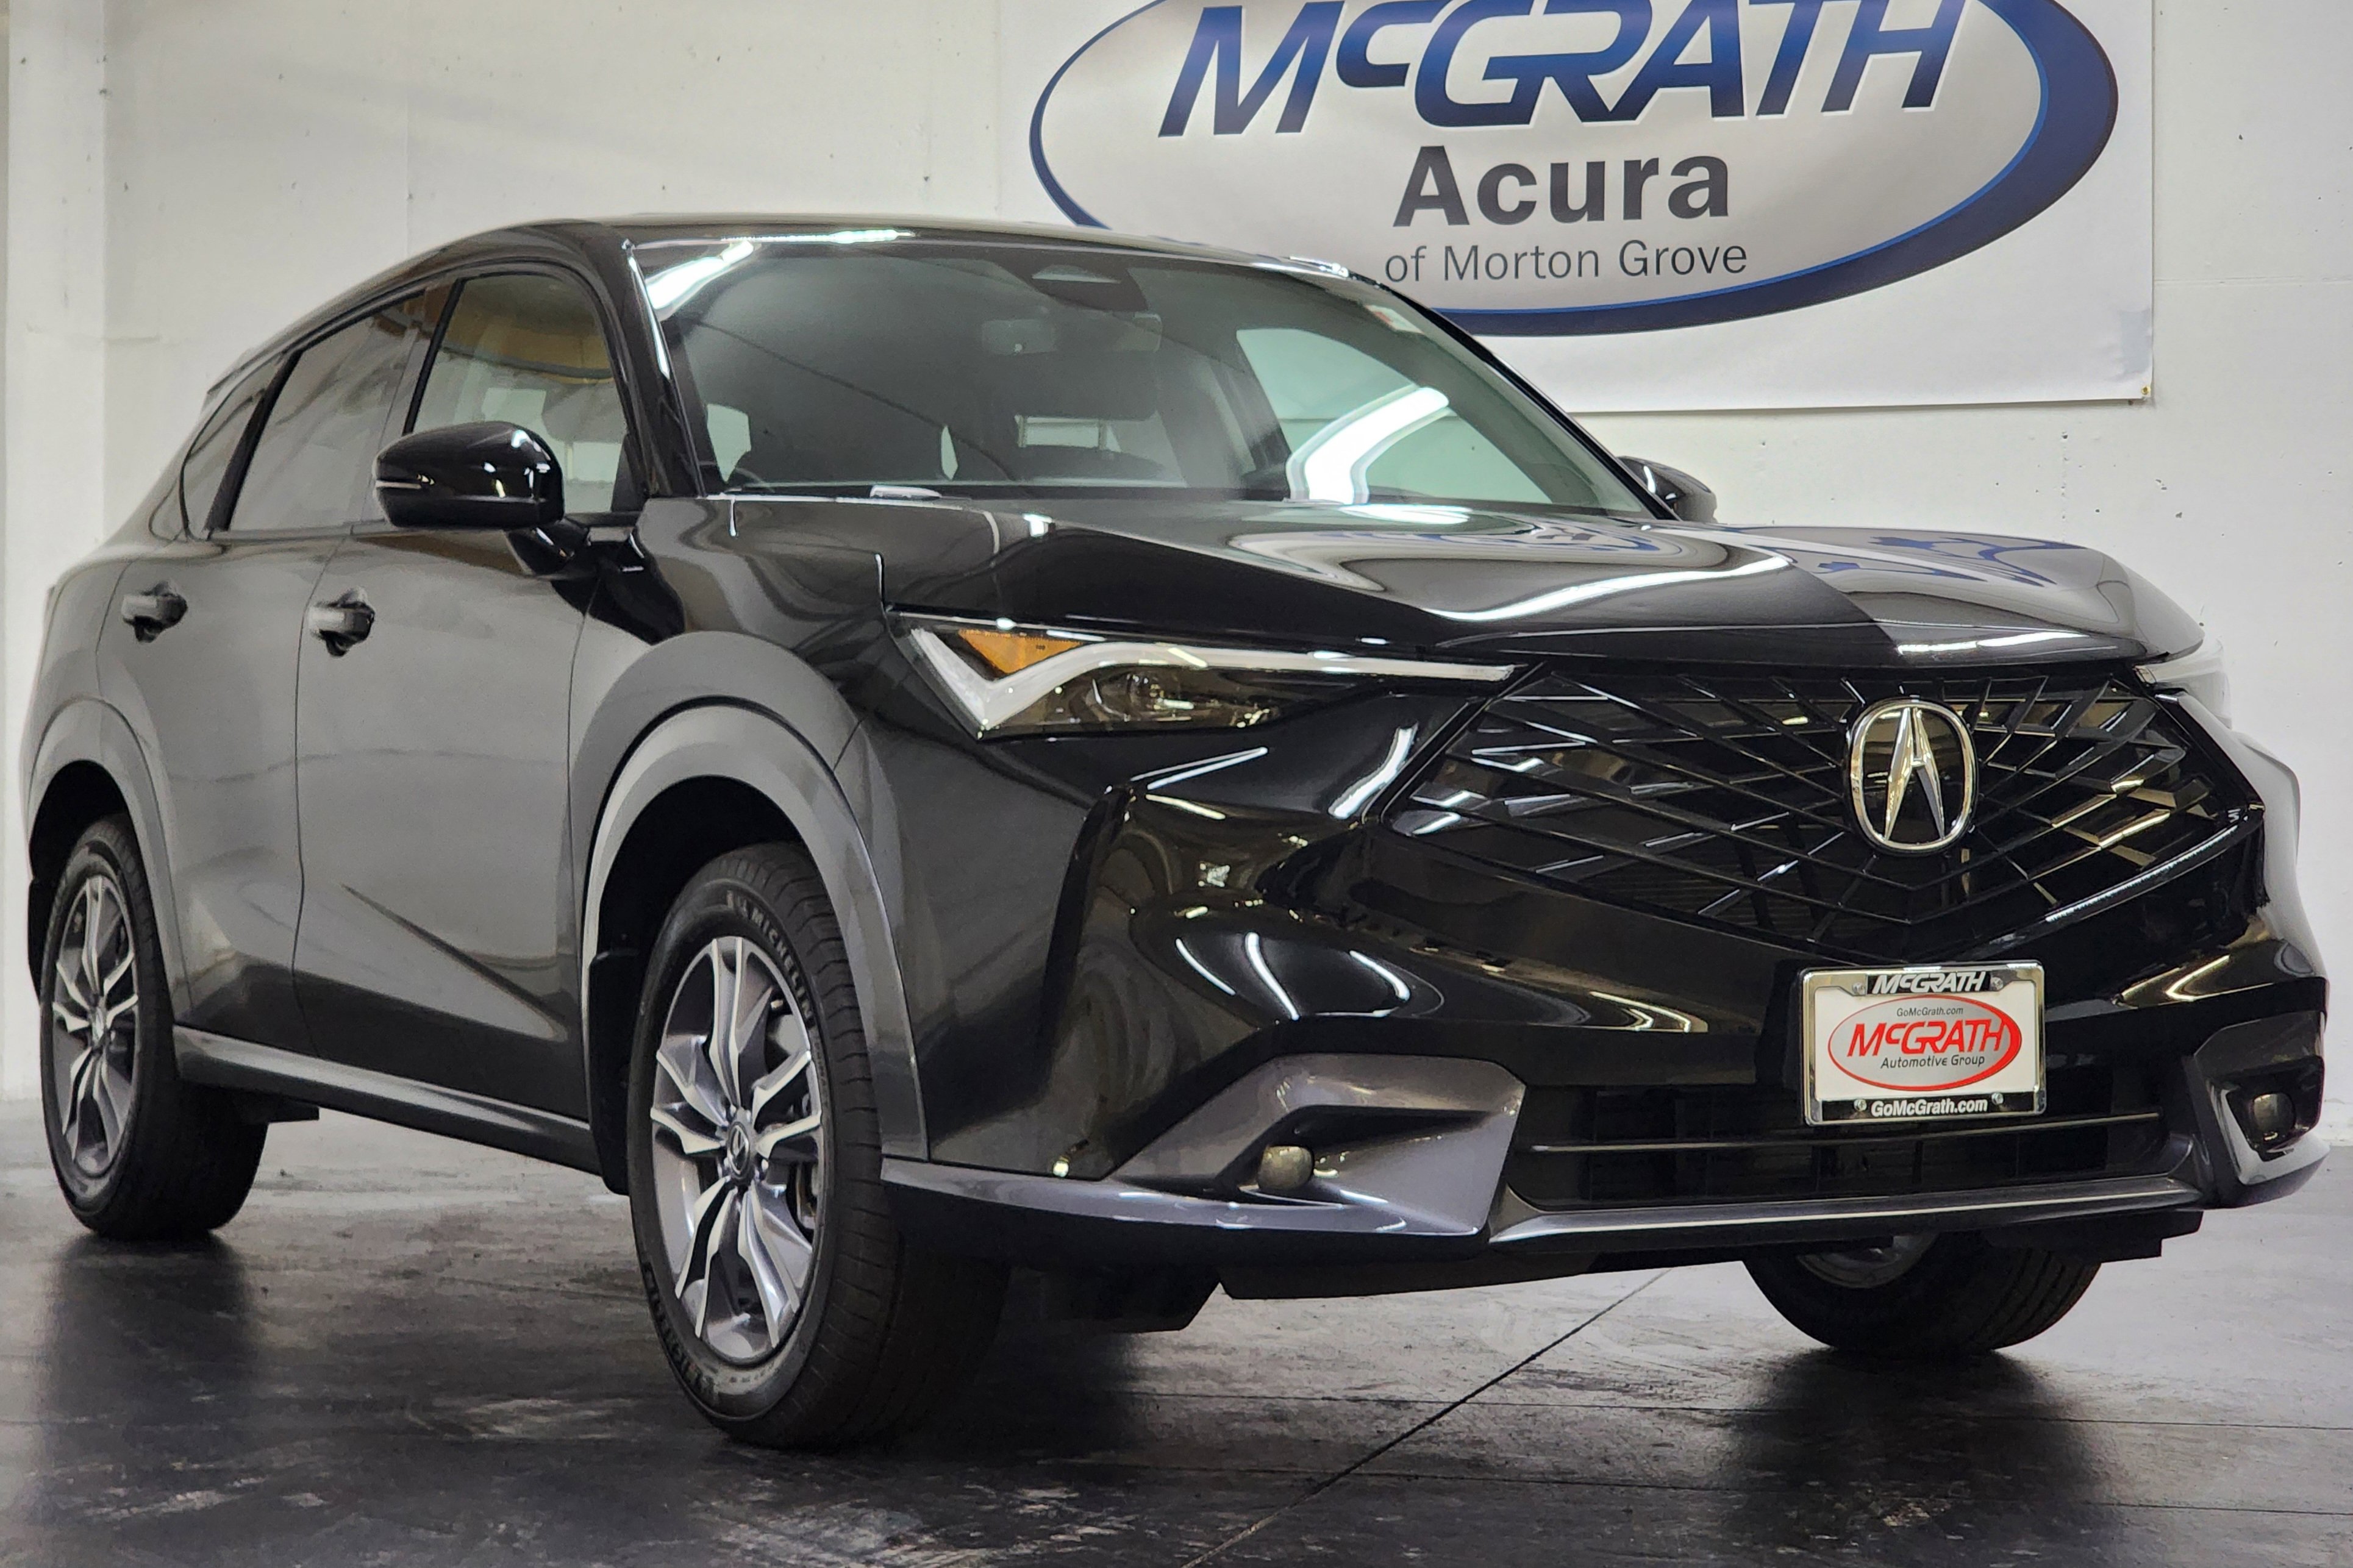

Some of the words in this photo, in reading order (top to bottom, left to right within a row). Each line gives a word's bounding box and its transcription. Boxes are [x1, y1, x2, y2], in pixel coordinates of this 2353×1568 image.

[1393, 146, 1729, 227] Acura
[1385, 246, 1427, 282] of
[1444, 245, 1599, 281] Morton
[1619, 240, 1747, 276] Grove
[750, 905, 816, 1021] MICHELIN
[1896, 1006, 1963, 1017] GoMcGrath.com
[1880, 1055, 1948, 1069] Automotive
[1951, 1054, 1985, 1067] Group
[1871, 1098, 1988, 1117] GoMcGrath.com
